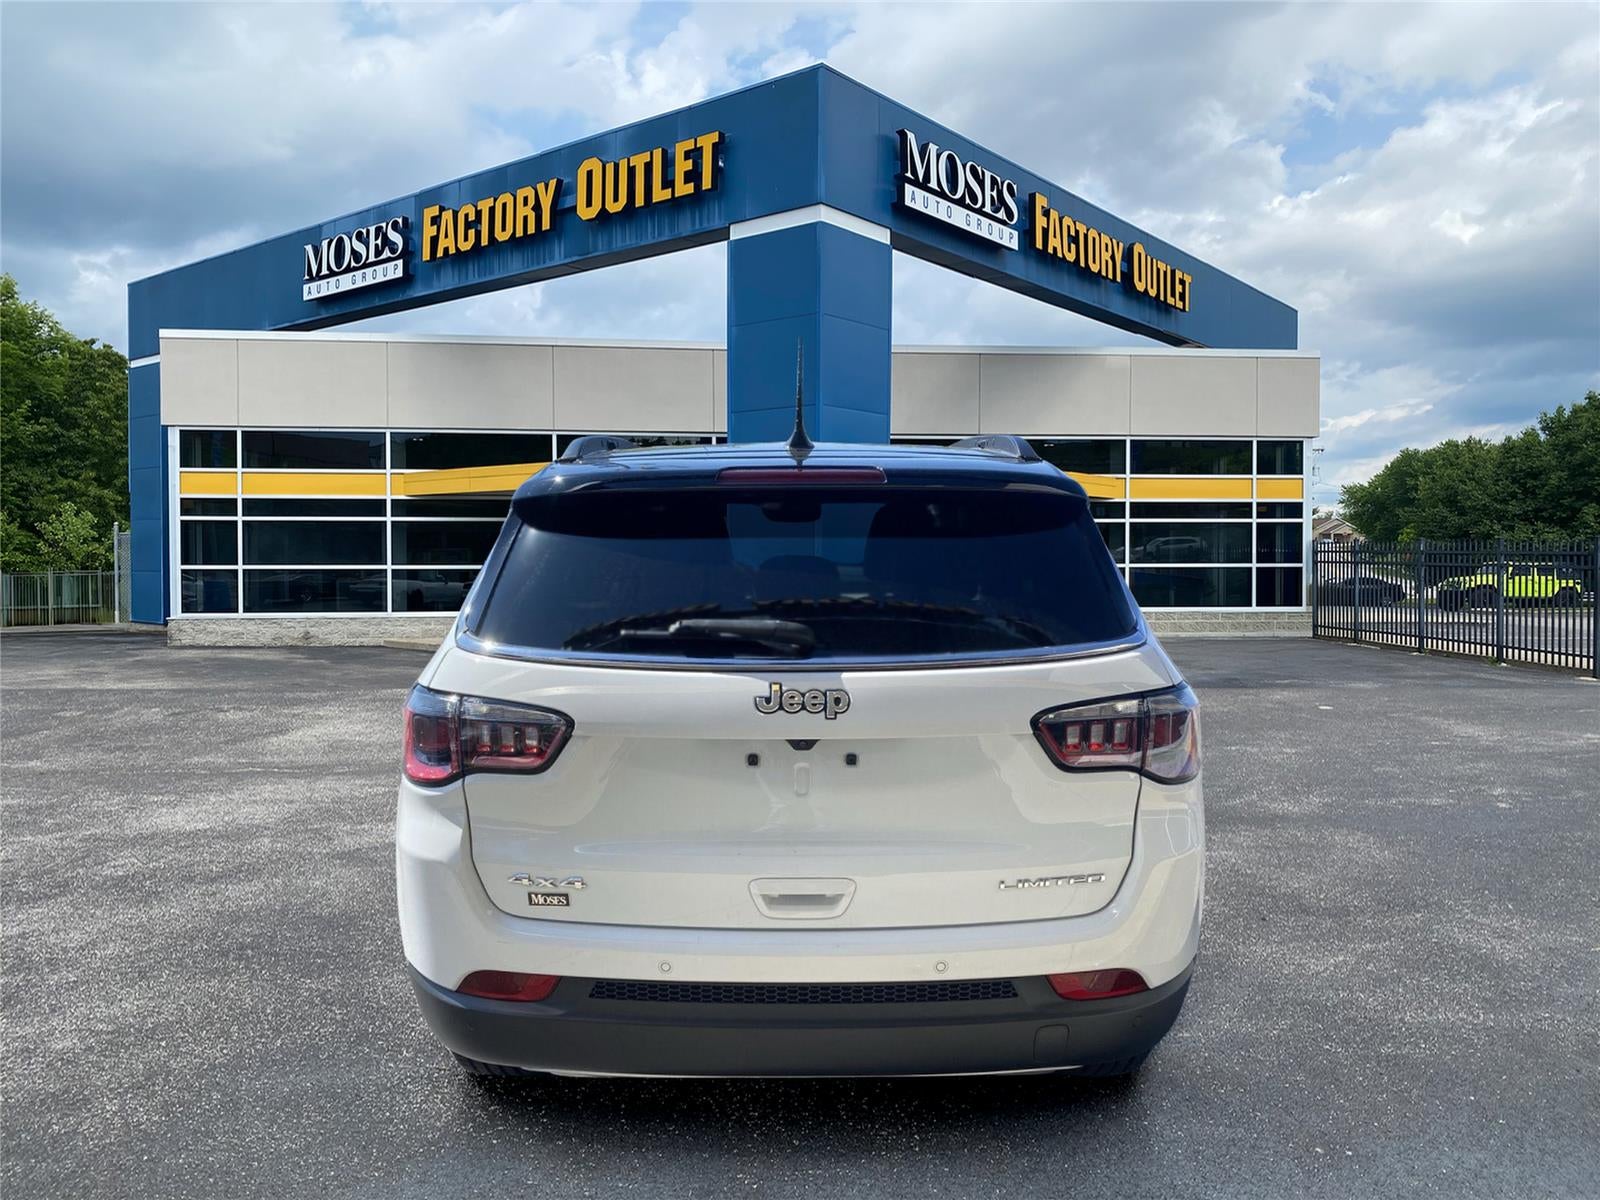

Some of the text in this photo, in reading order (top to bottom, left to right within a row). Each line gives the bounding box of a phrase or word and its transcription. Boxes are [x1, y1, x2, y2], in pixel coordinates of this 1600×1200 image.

[422, 131, 721, 262] FACTORY OUTLET
[903, 128, 1019, 226] MOSES
[910, 190, 1016, 245] AUTO GROUP
[303, 216, 404, 281] MOSES
[1034, 191, 1192, 312] FACTORY OUTLET
[306, 263, 401, 298] AUTO GROUP
[755, 682, 850, 720] Jeep
[530, 893, 567, 906] MOSES
[999, 873, 1106, 889] LIMITED
